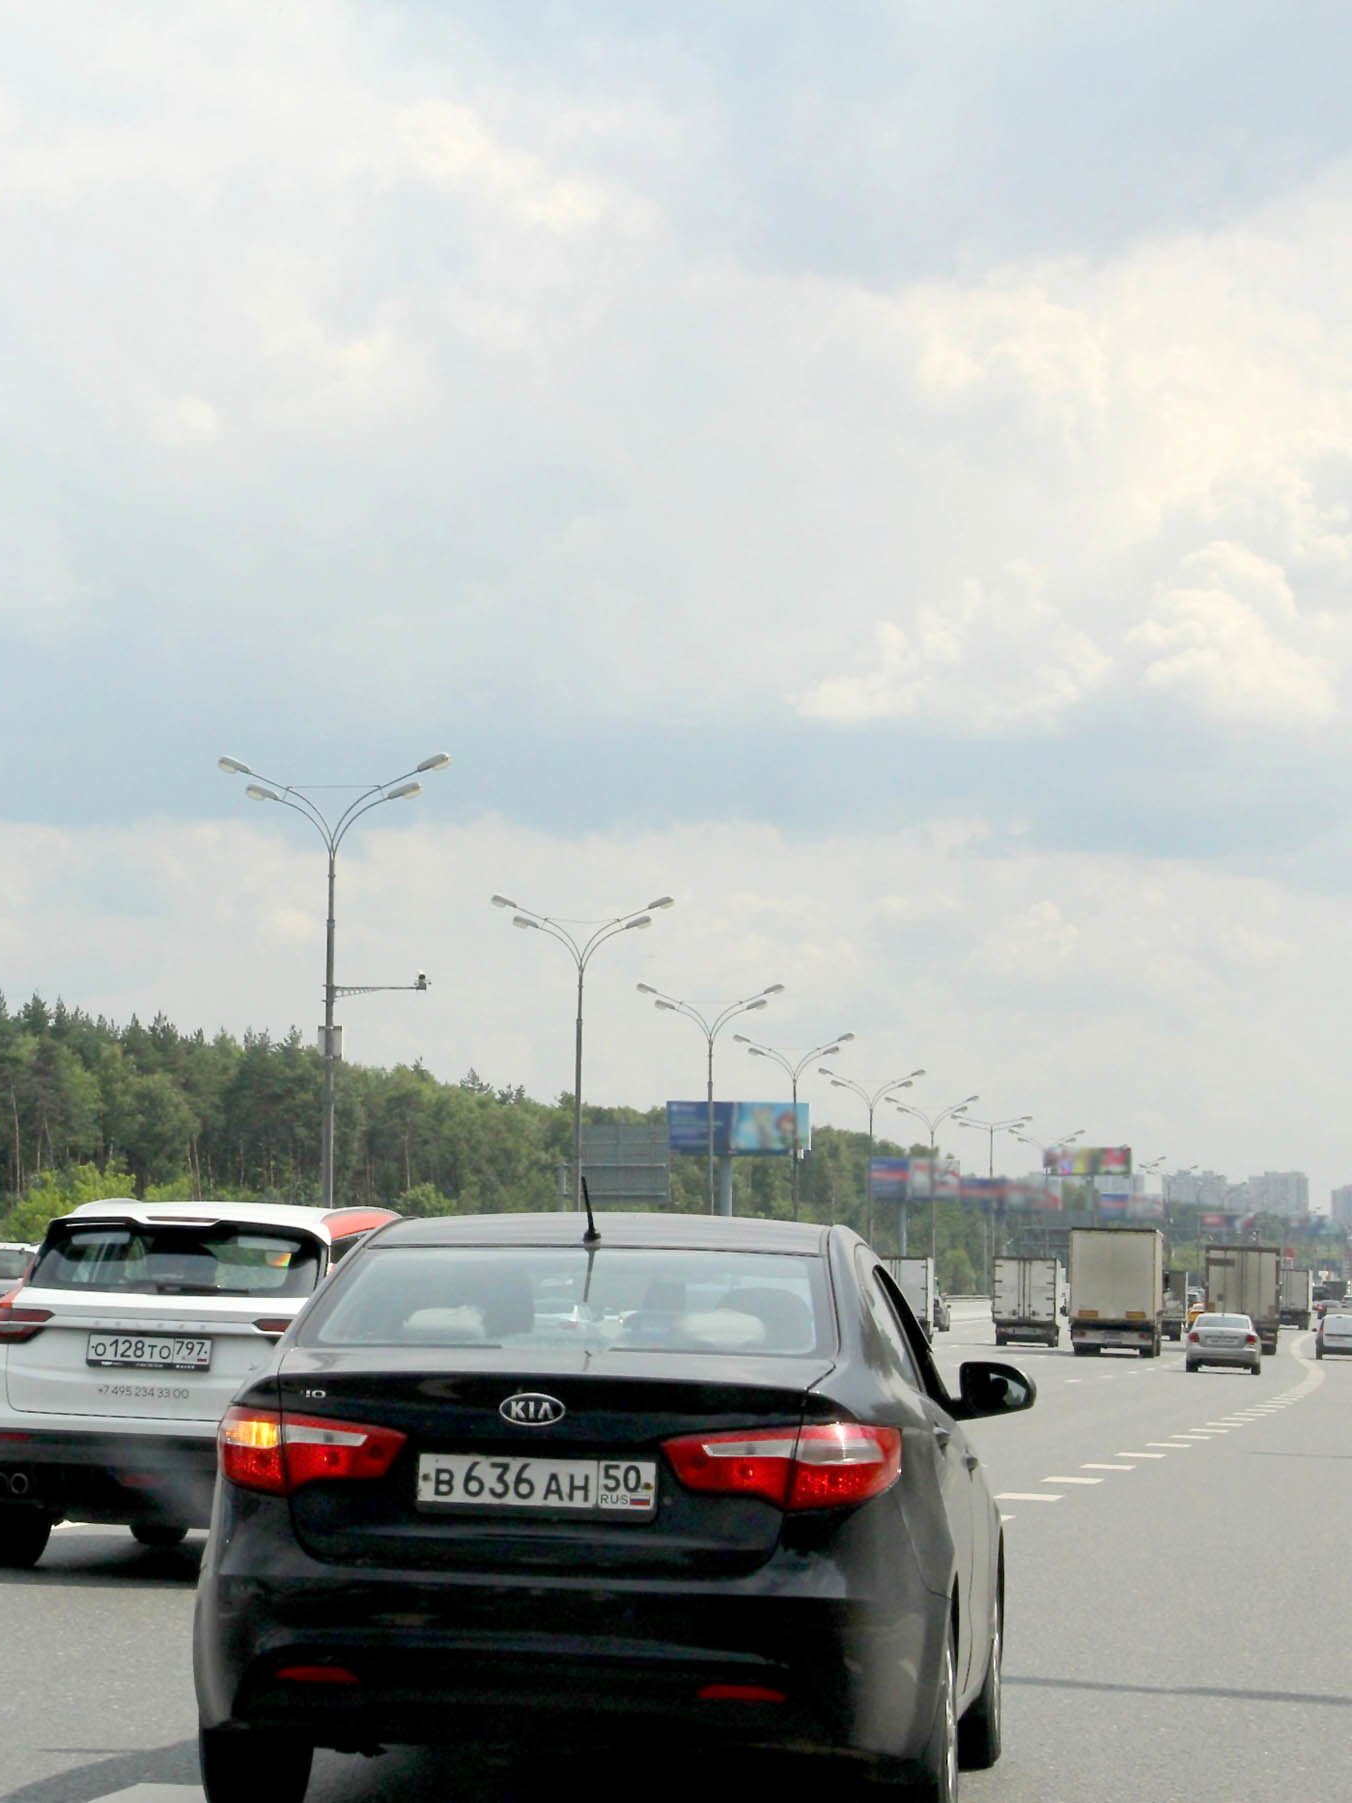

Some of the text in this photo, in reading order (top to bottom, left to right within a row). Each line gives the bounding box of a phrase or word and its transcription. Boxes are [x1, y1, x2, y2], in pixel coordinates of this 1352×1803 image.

[175, 1340, 206, 1357] 797
[510, 1400, 555, 1420] KIA
[602, 1464, 642, 1493] 50
[600, 1494, 629, 1505] RUS
